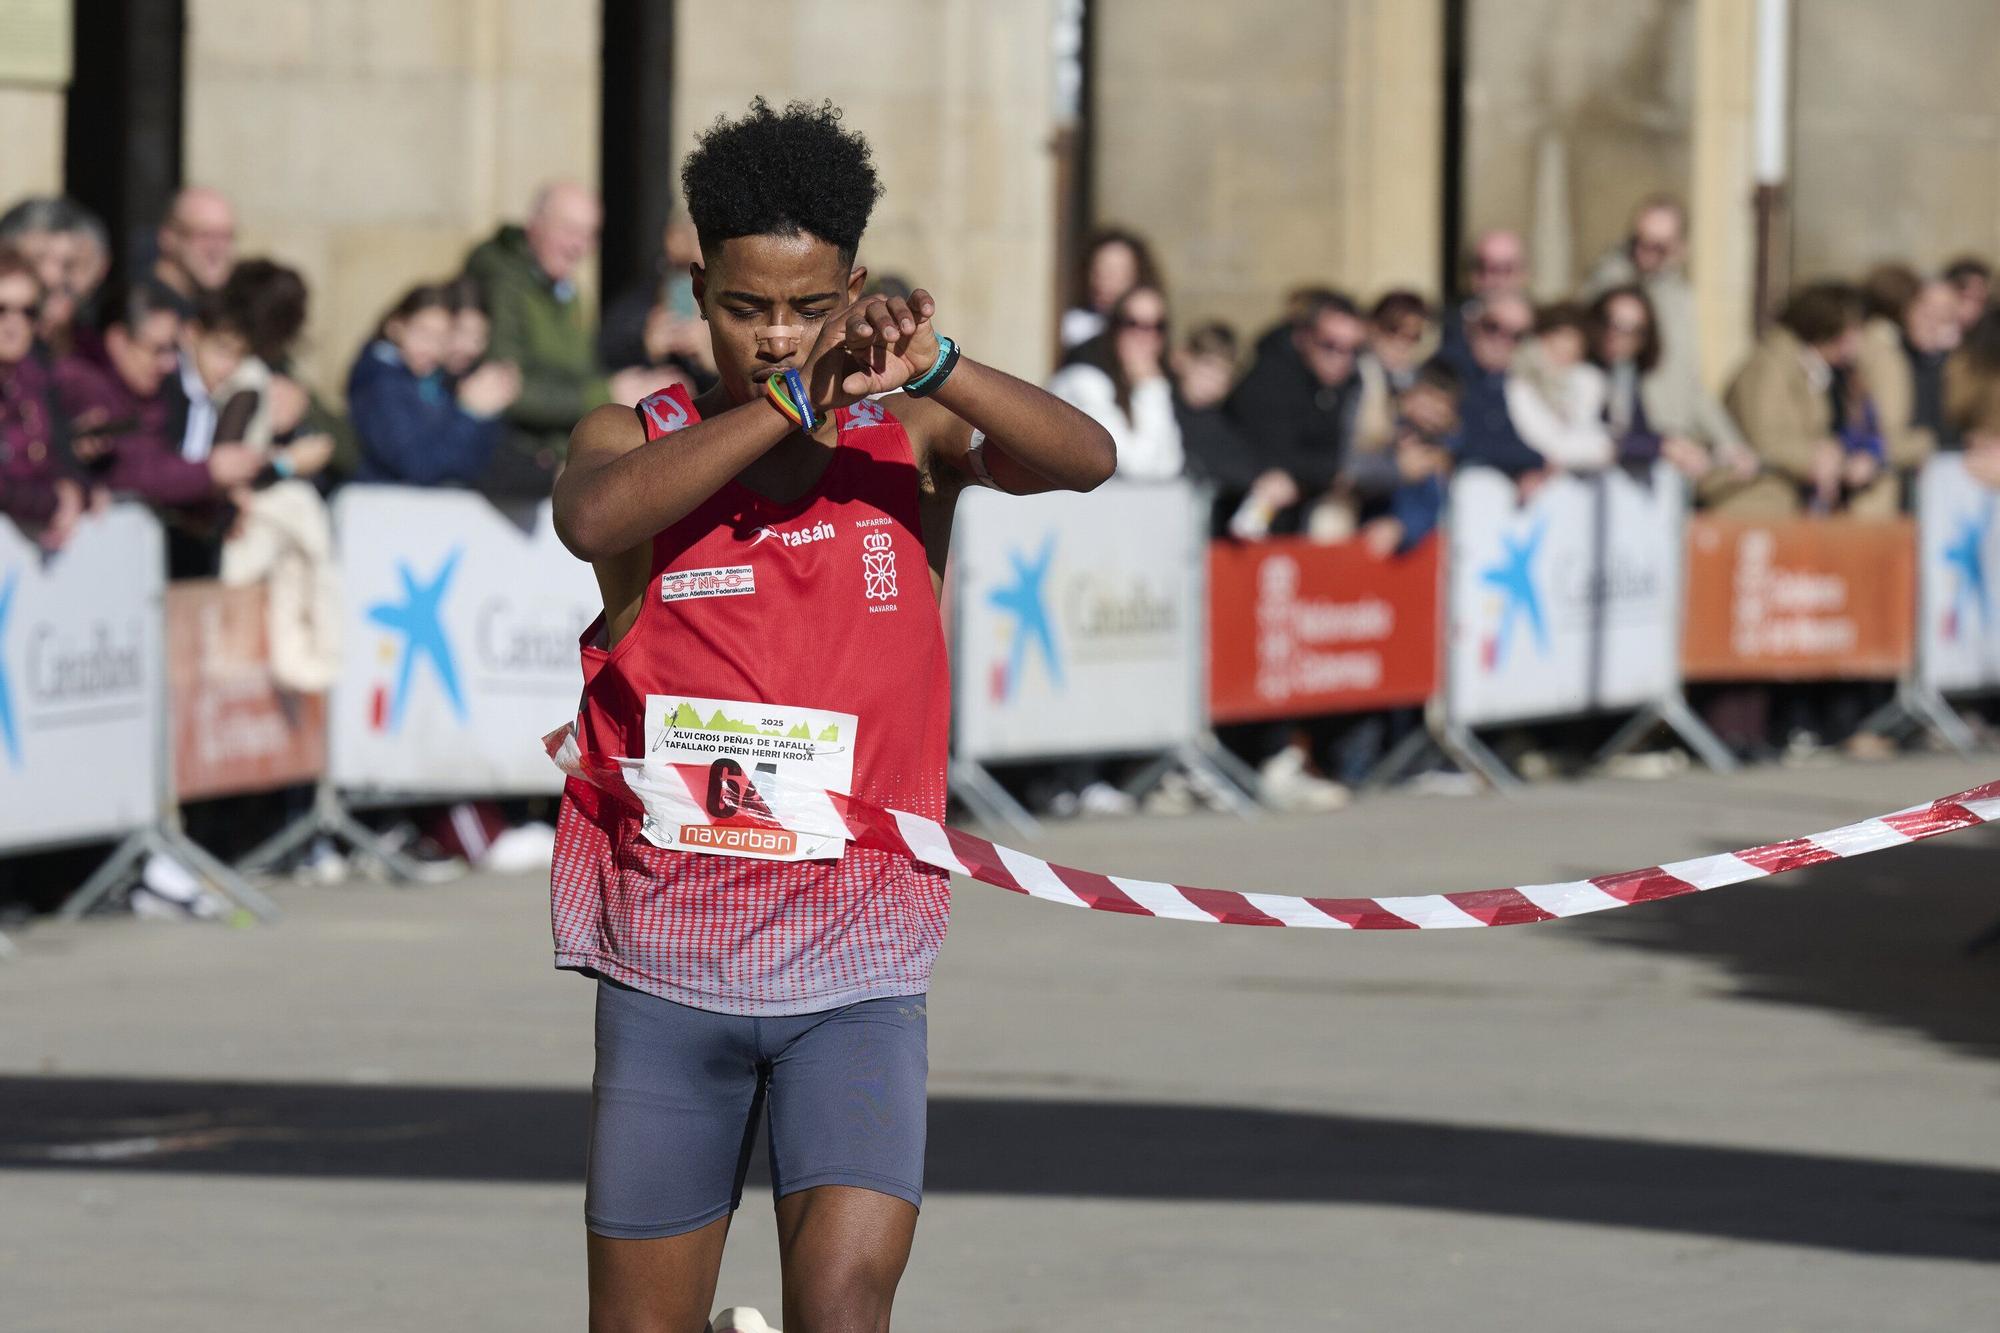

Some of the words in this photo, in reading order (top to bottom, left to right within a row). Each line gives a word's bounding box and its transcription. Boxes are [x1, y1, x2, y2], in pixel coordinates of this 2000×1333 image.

[856, 518, 893, 528] NAFARROA
[663, 573, 688, 582] Federación
[663, 592, 688, 600] Nafarroako
[716, 587, 754, 595] Federakuntza
[869, 604, 898, 613] NAVARRA
[760, 718, 784, 728] 2025
[673, 731, 694, 742] XLVI
[694, 732, 721, 743] CROSS
[723, 733, 754, 746] PEÑAS
[757, 738, 771, 747] DE
[664, 740, 716, 753] TAFALLAKO
[718, 742, 750, 756] PEÑEN
[752, 747, 780, 759] HERRI
[782, 750, 814, 762] KROSA
[685, 825, 791, 851] navarban
